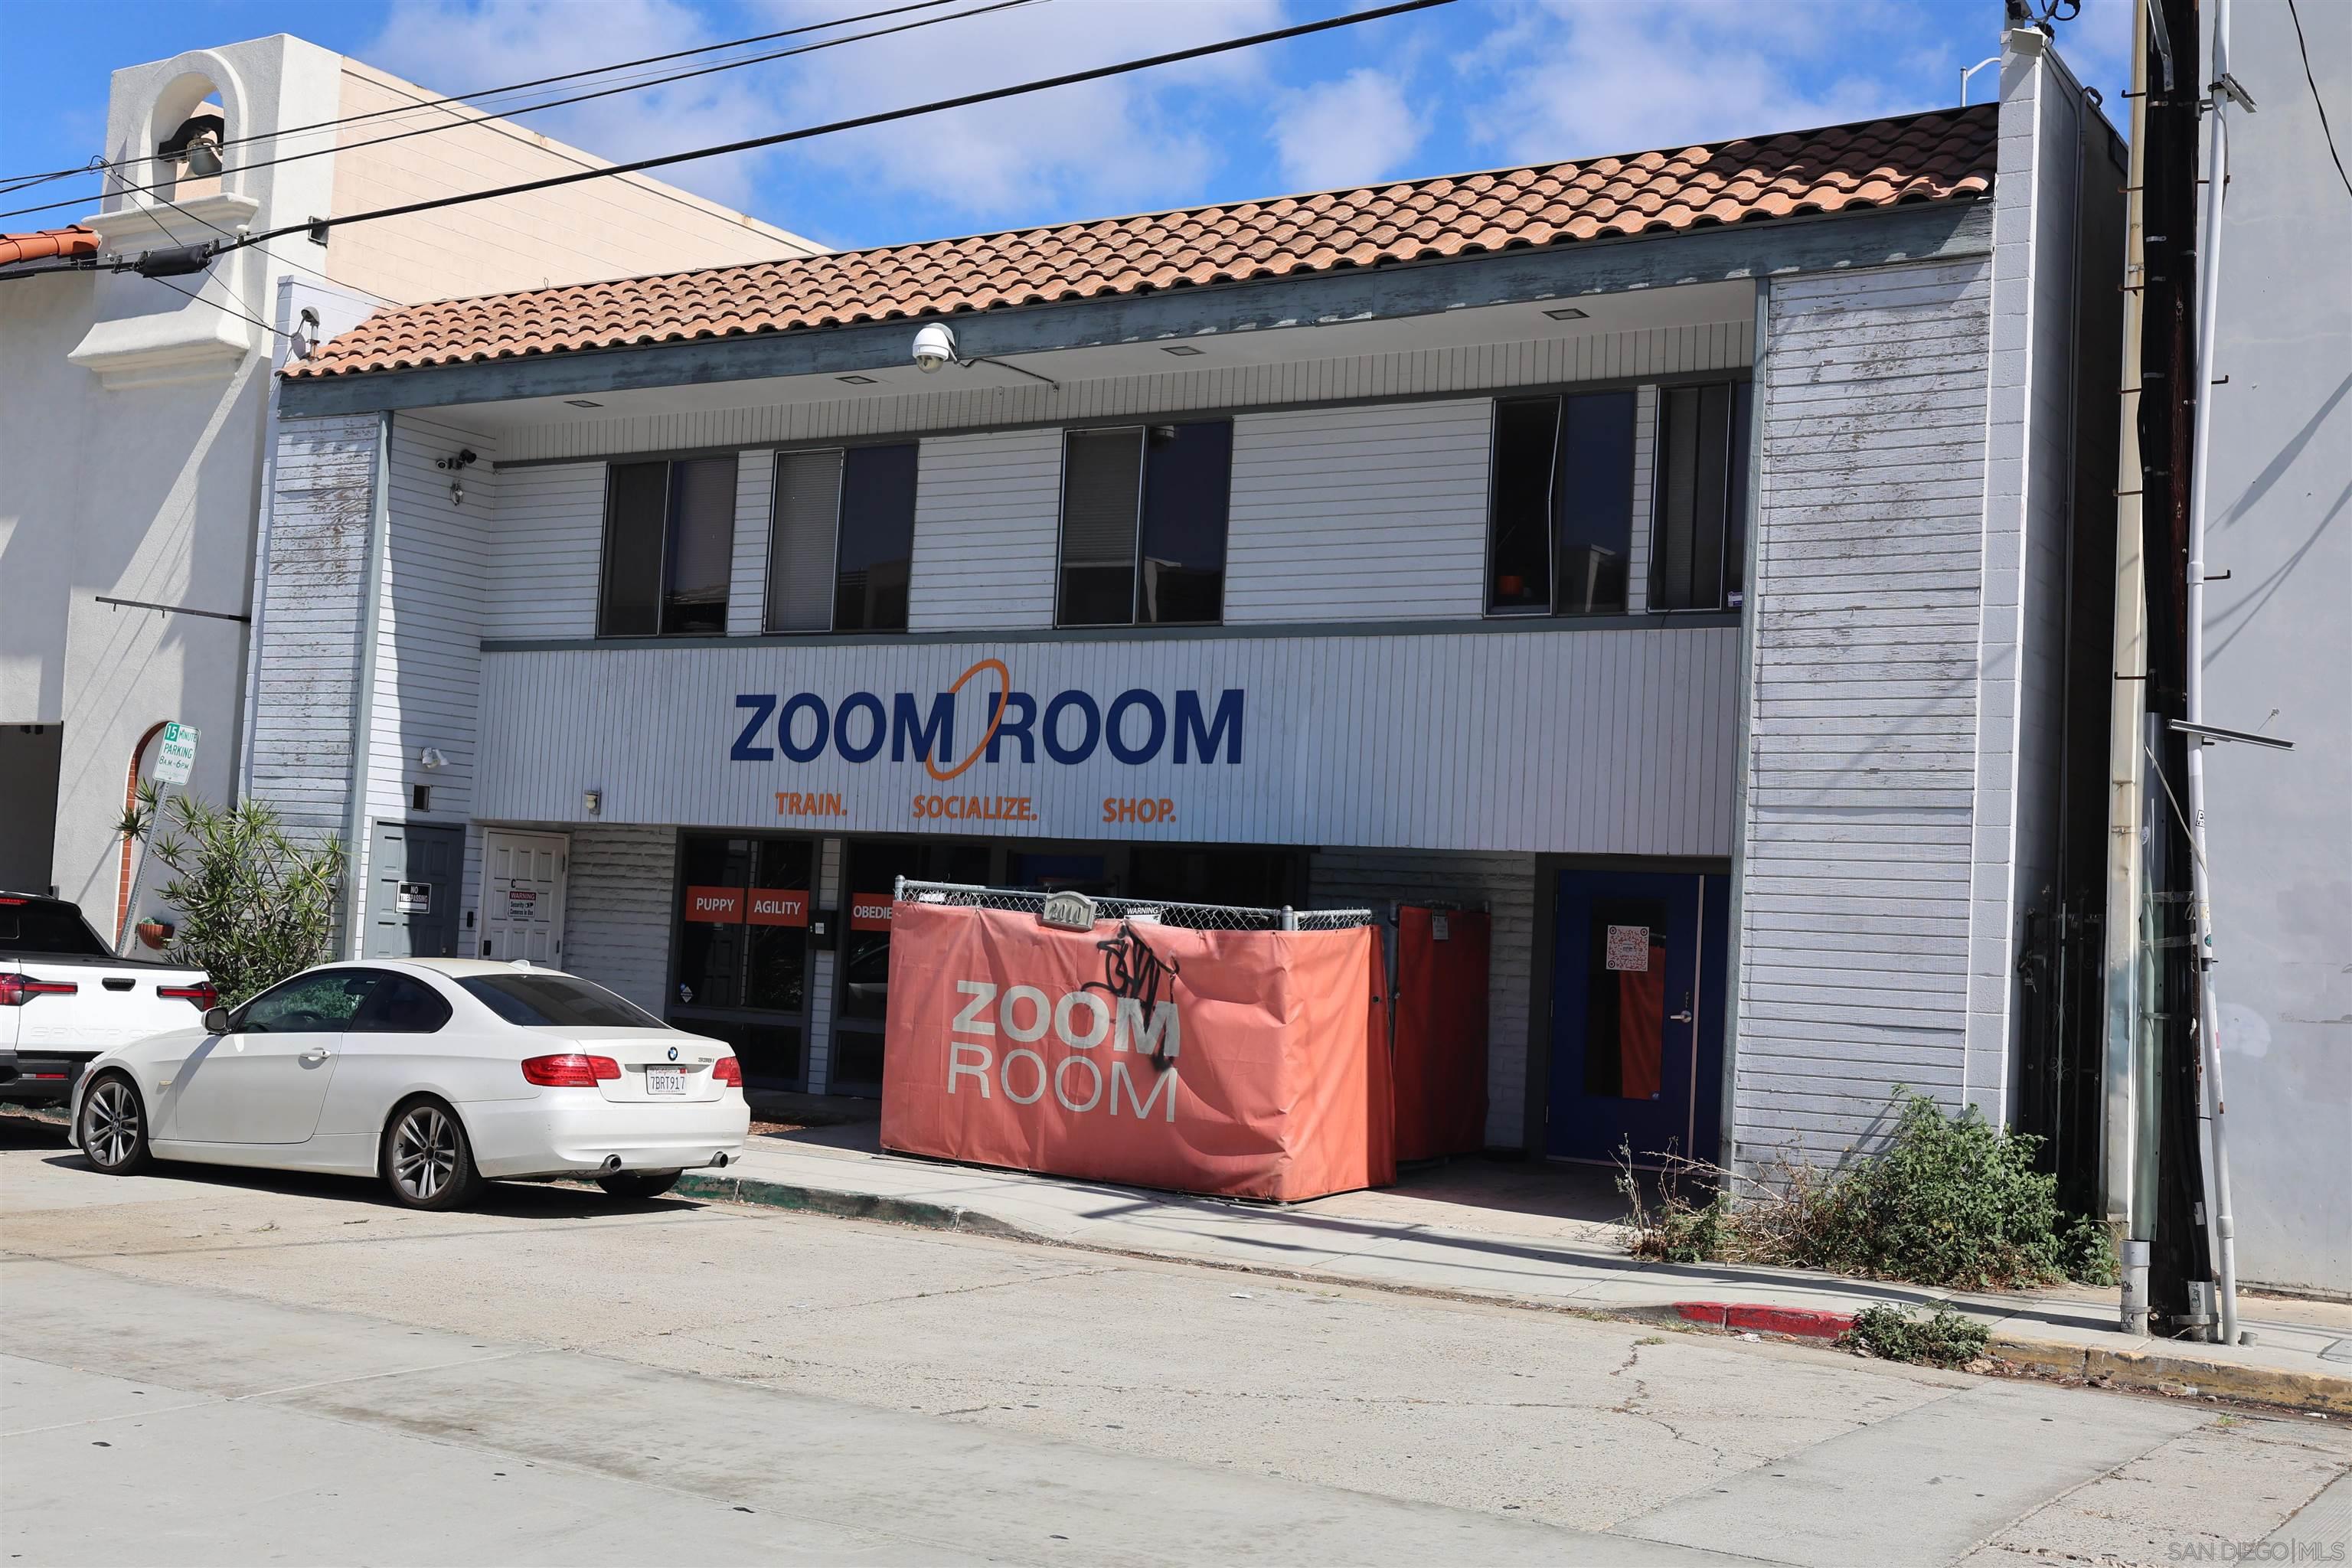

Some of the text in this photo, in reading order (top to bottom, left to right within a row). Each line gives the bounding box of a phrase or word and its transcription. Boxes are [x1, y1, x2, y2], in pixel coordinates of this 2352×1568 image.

[166, 725, 198, 742] 15 MINUTE
[730, 689, 1244, 765] ZOOM ROOM
[164, 743, 193, 759] PARKING
[775, 792, 1176, 823] TRAIN. SOCIALIZE. SHOP.
[410, 886, 419, 894] NO
[511, 879, 516, 888] C
[400, 893, 429, 903] TRESPASSING
[696, 897, 734, 912] PUPPY
[754, 900, 802, 915] AGILITY
[853, 905, 893, 919] OBEDIE
[1126, 906, 1158, 915] WARNING
[952, 980, 1181, 1057] ZOOM
[651, 1076, 684, 1089] 7BRT917
[948, 1041, 1178, 1122] ROOM
